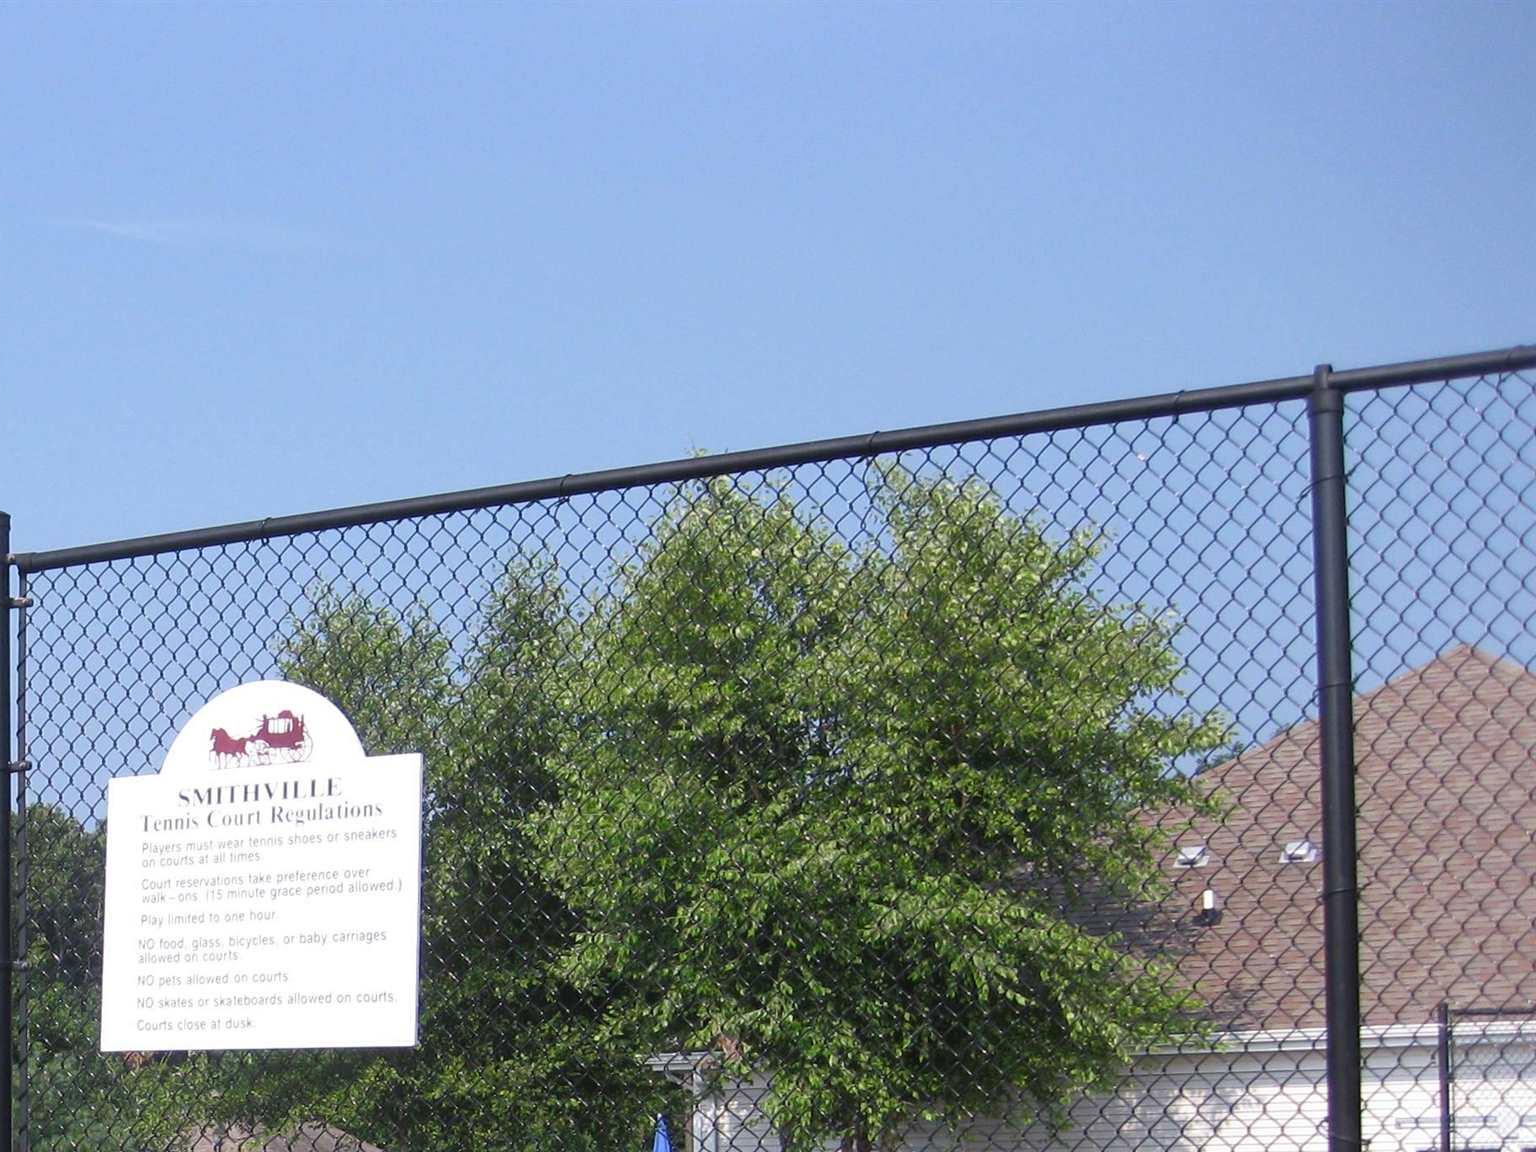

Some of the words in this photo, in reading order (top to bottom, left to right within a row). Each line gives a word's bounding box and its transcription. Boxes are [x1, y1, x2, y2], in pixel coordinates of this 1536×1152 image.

[178, 777, 342, 807] SMITHVILLE
[142, 812, 199, 832] Tennis
[207, 809, 260, 828] Court
[271, 801, 383, 825] Regulations
[142, 841, 182, 855] Players
[185, 840, 213, 851] must
[217, 838, 244, 849] wear
[249, 835, 284, 848] tennis
[288, 833, 322, 846] shoes
[326, 832, 340, 843] or
[344, 827, 397, 841] sneakers
[142, 858, 156, 868] on
[160, 855, 194, 867] courts
[198, 854, 209, 865] at
[213, 851, 226, 864] all
[141, 878, 171, 890] Court
[176, 874, 245, 888] reservations
[248, 871, 272, 884] take
[276, 870, 339, 885] preference
[344, 868, 370, 879] over
[227, 887, 265, 899] minute
[270, 886, 302, 901] grace
[307, 882, 344, 898] period
[141, 914, 164, 929] Play
[168, 911, 206, 926] limited
[208, 913, 220, 923] to
[224, 913, 245, 923] one
[138, 938, 156, 950] NO
[283, 935, 295, 945] or
[299, 932, 327, 947] baby
[332, 930, 387, 945] carriages
[138, 951, 180, 964] allowed
[184, 953, 198, 963] on
[137, 974, 154, 987] NO
[158, 975, 182, 989] pets
[186, 971, 229, 985] allowed
[234, 973, 248, 984] on
[137, 996, 154, 1009] NO
[158, 996, 194, 1009] skates
[198, 998, 210, 1008] or
[213, 993, 283, 1008] skateboards
[288, 992, 333, 1005] allowed
[336, 993, 352, 1004] on
[136, 1019, 173, 1031] Courts
[177, 1018, 207, 1031] close
[210, 1018, 221, 1030] at
